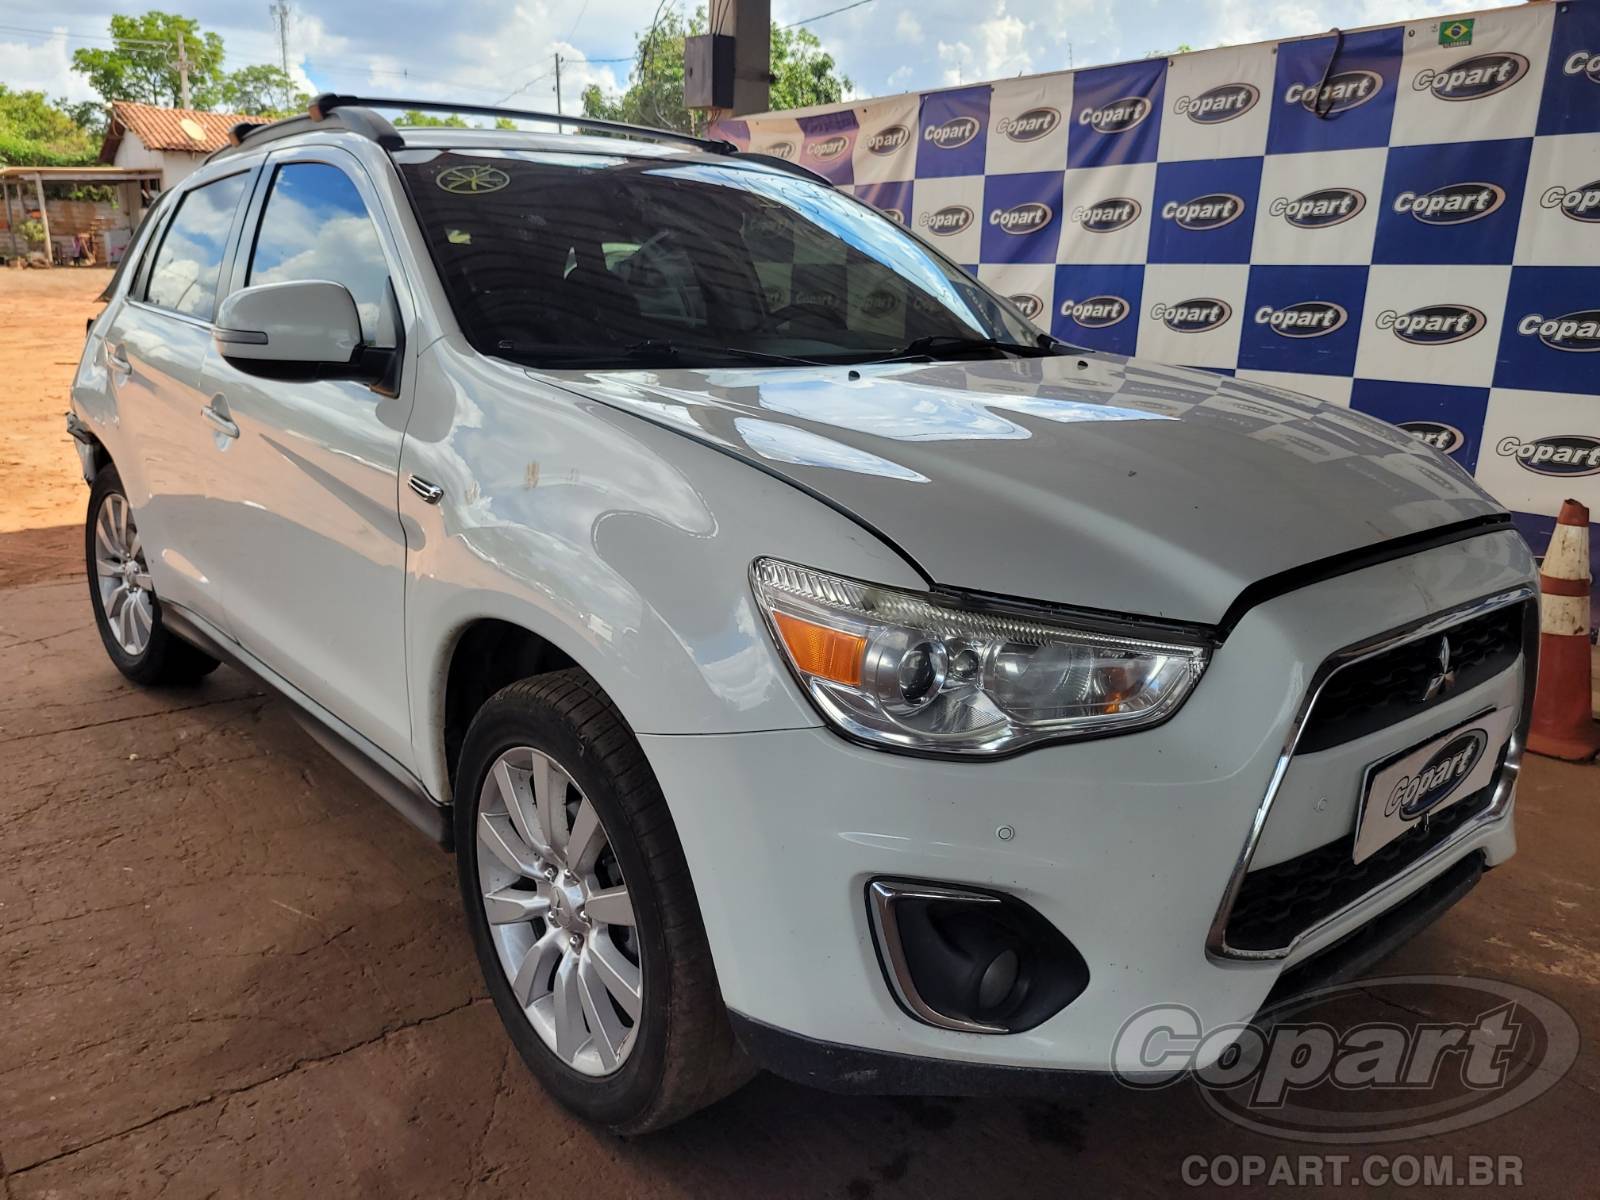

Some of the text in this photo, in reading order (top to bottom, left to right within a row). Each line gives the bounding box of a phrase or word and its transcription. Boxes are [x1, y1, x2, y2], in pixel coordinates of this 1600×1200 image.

[1412, 58, 1512, 93] Copart
[1174, 91, 1247, 116] Copart
[997, 113, 1052, 137] Copart
[1079, 103, 1143, 129] Copart
[925, 122, 971, 145] Copart
[807, 138, 844, 156] Copart
[1072, 203, 1131, 225] Copart
[1162, 198, 1233, 222] Copart
[1270, 194, 1351, 220] Copart
[1394, 190, 1492, 217] Copart
[919, 210, 967, 231] Copart
[990, 208, 1044, 228] Copart
[1061, 300, 1121, 321] Copart
[1151, 302, 1220, 325] Copart
[1255, 305, 1336, 328] Copart
[1376, 310, 1470, 336] Copart
[1497, 436, 1600, 467] Copart
[1385, 739, 1477, 818] Copart
